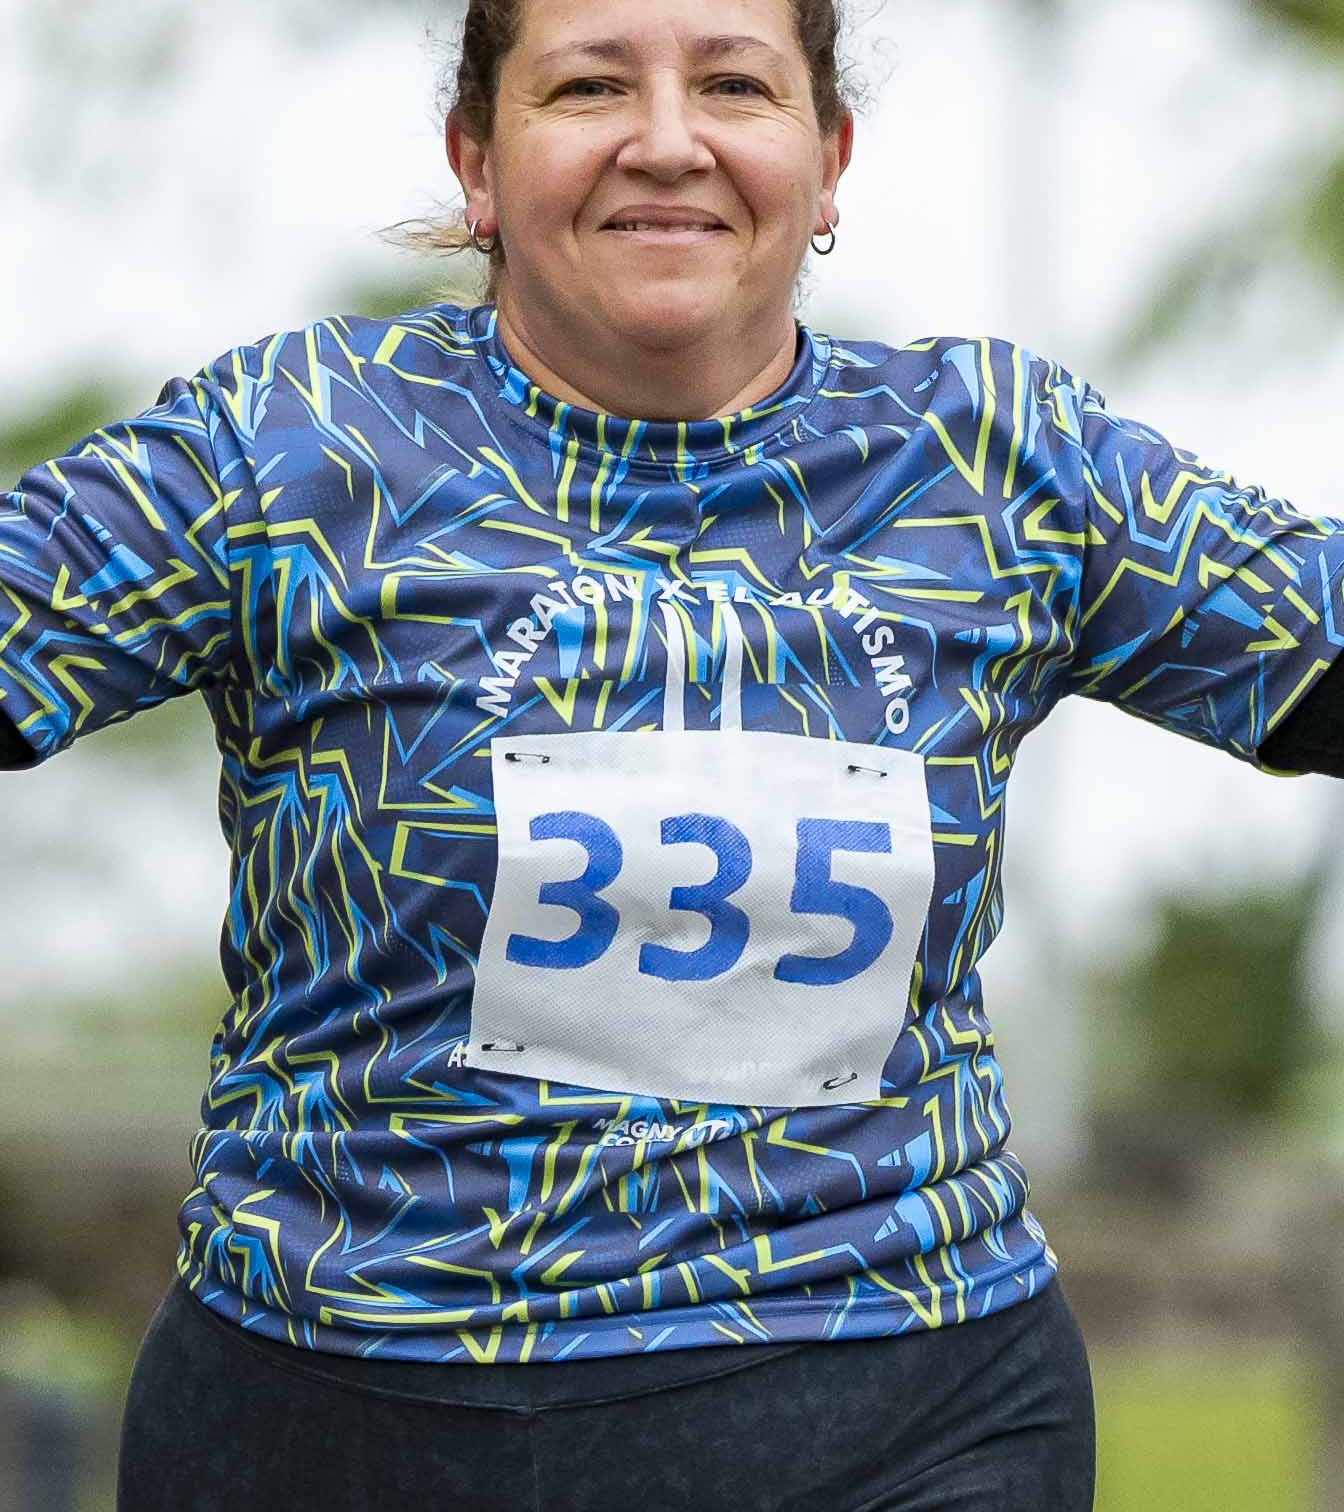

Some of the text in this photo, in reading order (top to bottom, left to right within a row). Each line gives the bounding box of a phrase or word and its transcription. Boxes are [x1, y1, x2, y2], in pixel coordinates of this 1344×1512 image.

[476, 566, 913, 735] MARATÓN X EL AUTISMO
[505, 810, 894, 986] 335
